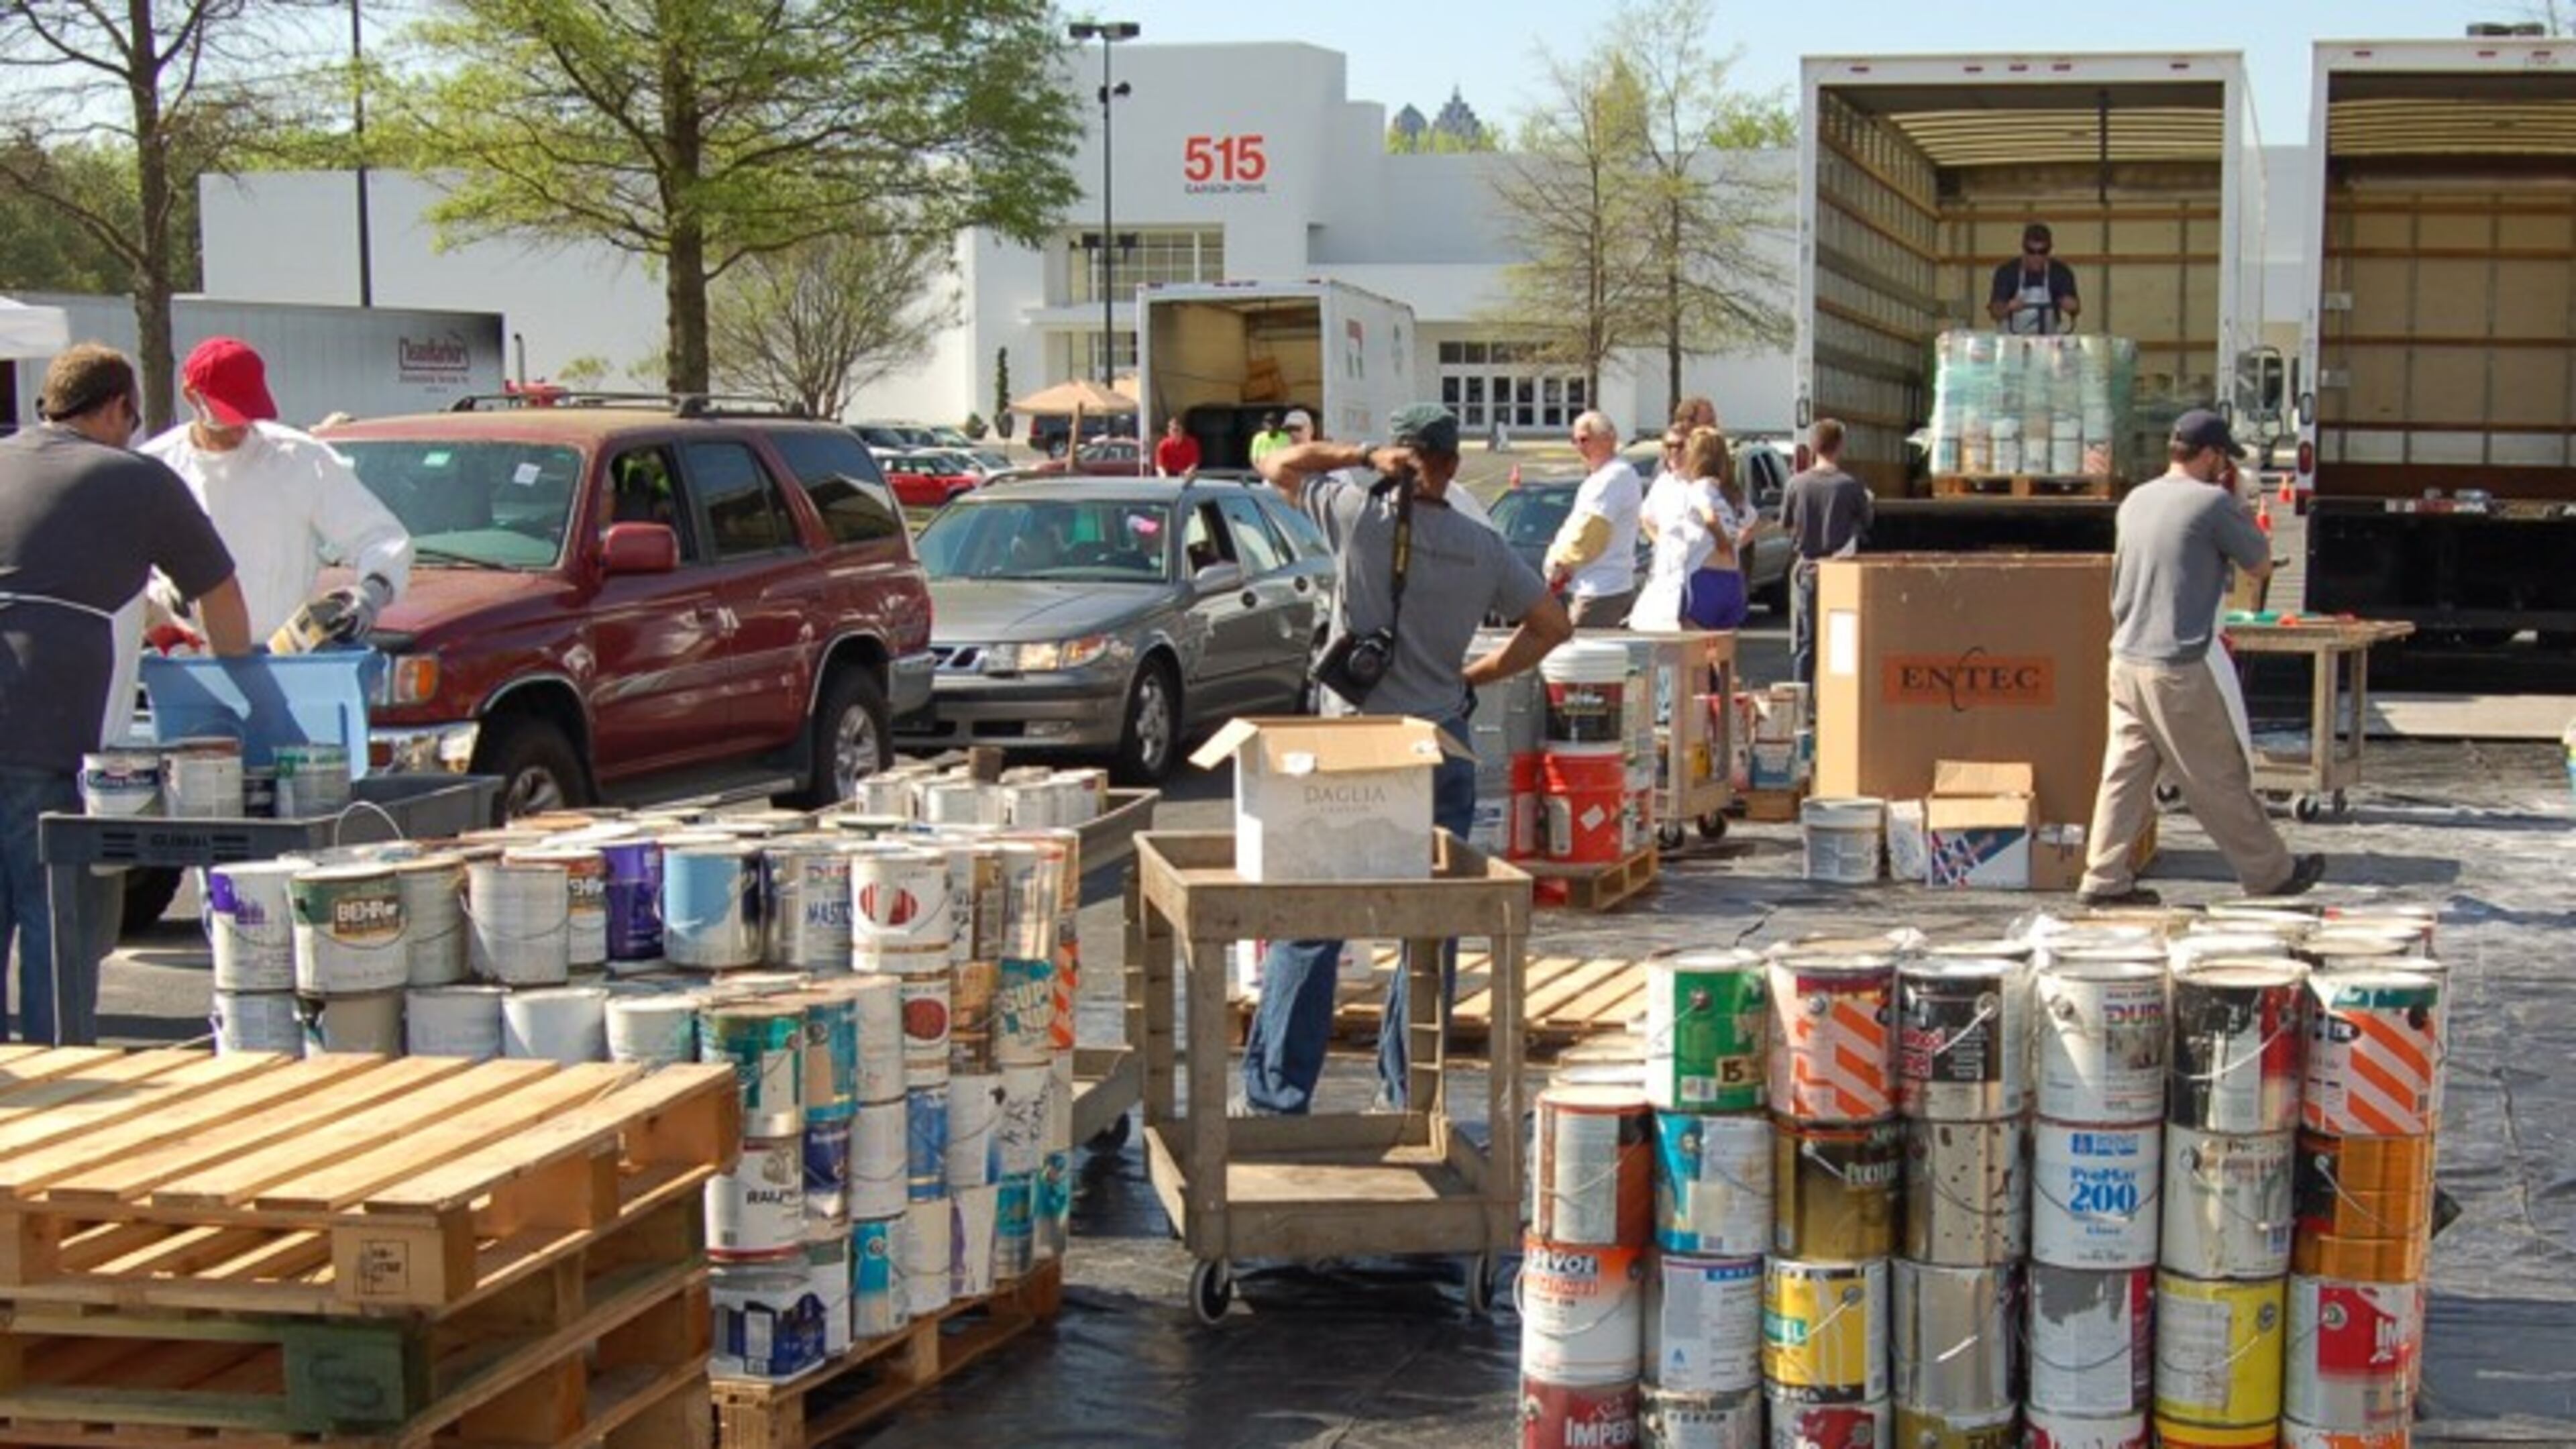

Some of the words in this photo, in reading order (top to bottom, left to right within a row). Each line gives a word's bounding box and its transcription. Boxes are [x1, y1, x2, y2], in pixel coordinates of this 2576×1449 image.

[1184, 135, 1267, 182] 515
[1303, 786, 1386, 804] DAGLIA
[2070, 1182, 2137, 1212] 200
